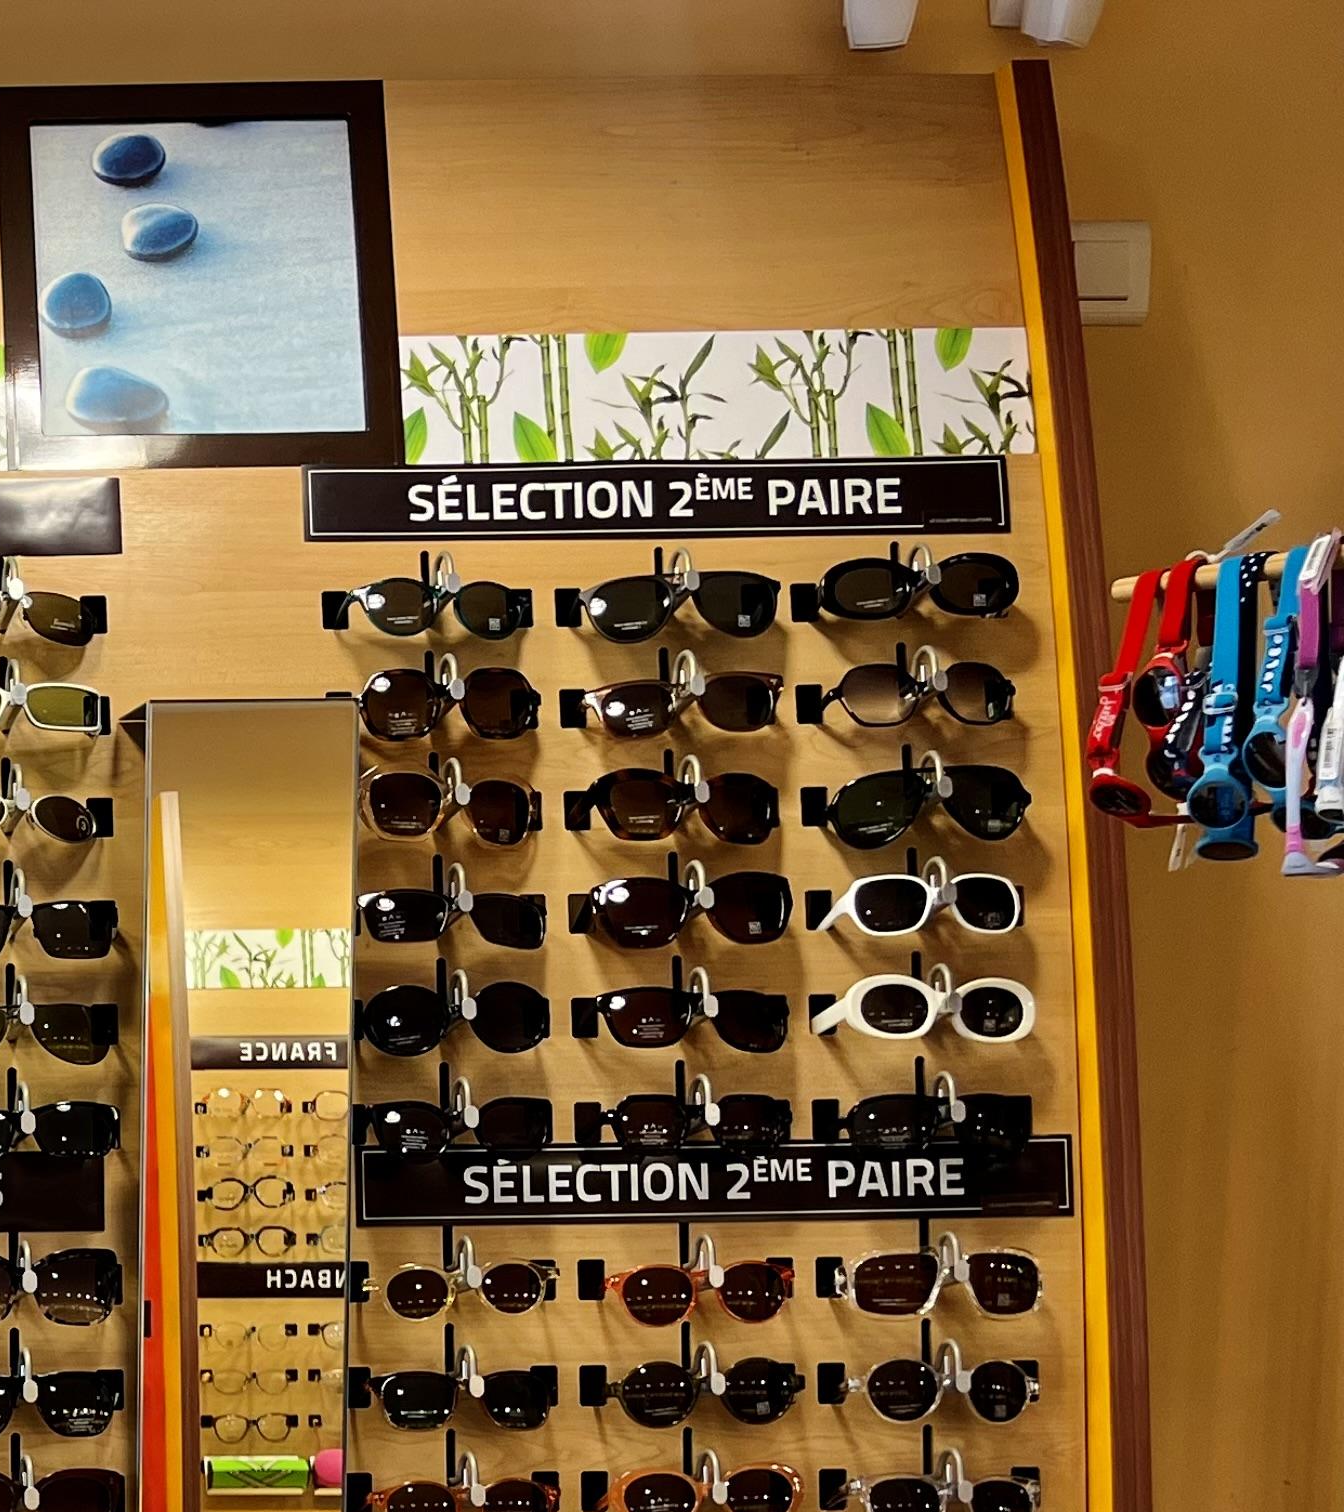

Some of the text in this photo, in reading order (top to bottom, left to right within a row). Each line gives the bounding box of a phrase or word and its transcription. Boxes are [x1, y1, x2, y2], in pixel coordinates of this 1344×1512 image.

[407, 474, 903, 522] SÉLECTION 2ÈME PAIRE
[828, 1158, 966, 1199] PAIRE
